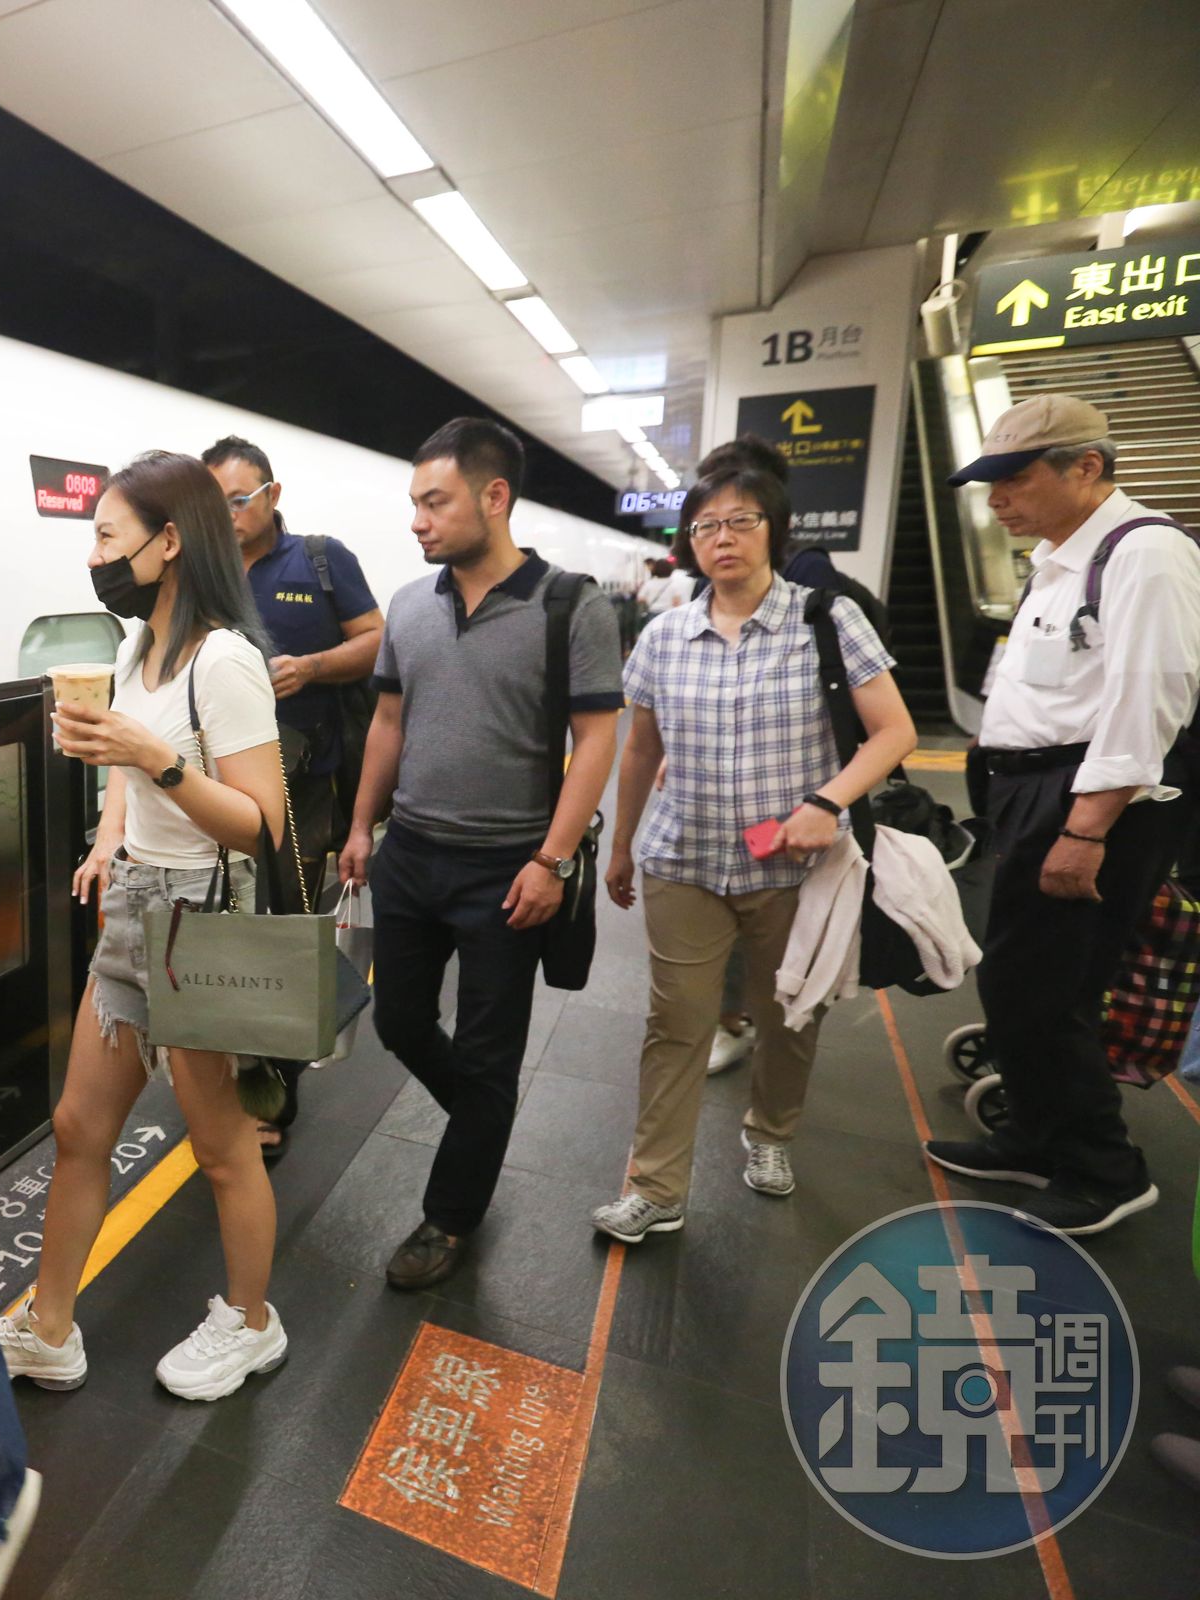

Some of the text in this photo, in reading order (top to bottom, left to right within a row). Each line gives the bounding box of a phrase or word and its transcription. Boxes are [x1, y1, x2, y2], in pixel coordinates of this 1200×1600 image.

[1064, 294, 1189, 329] East exit
[818, 323, 863, 347] 月台
[761, 330, 814, 367] 1B
[65, 473, 96, 496] 0603
[37, 489, 84, 511] Reserved
[620, 490, 688, 513] 06:48
[181, 972, 285, 991] ALLSAINTS
[474, 1382, 549, 1528] Waiting line
